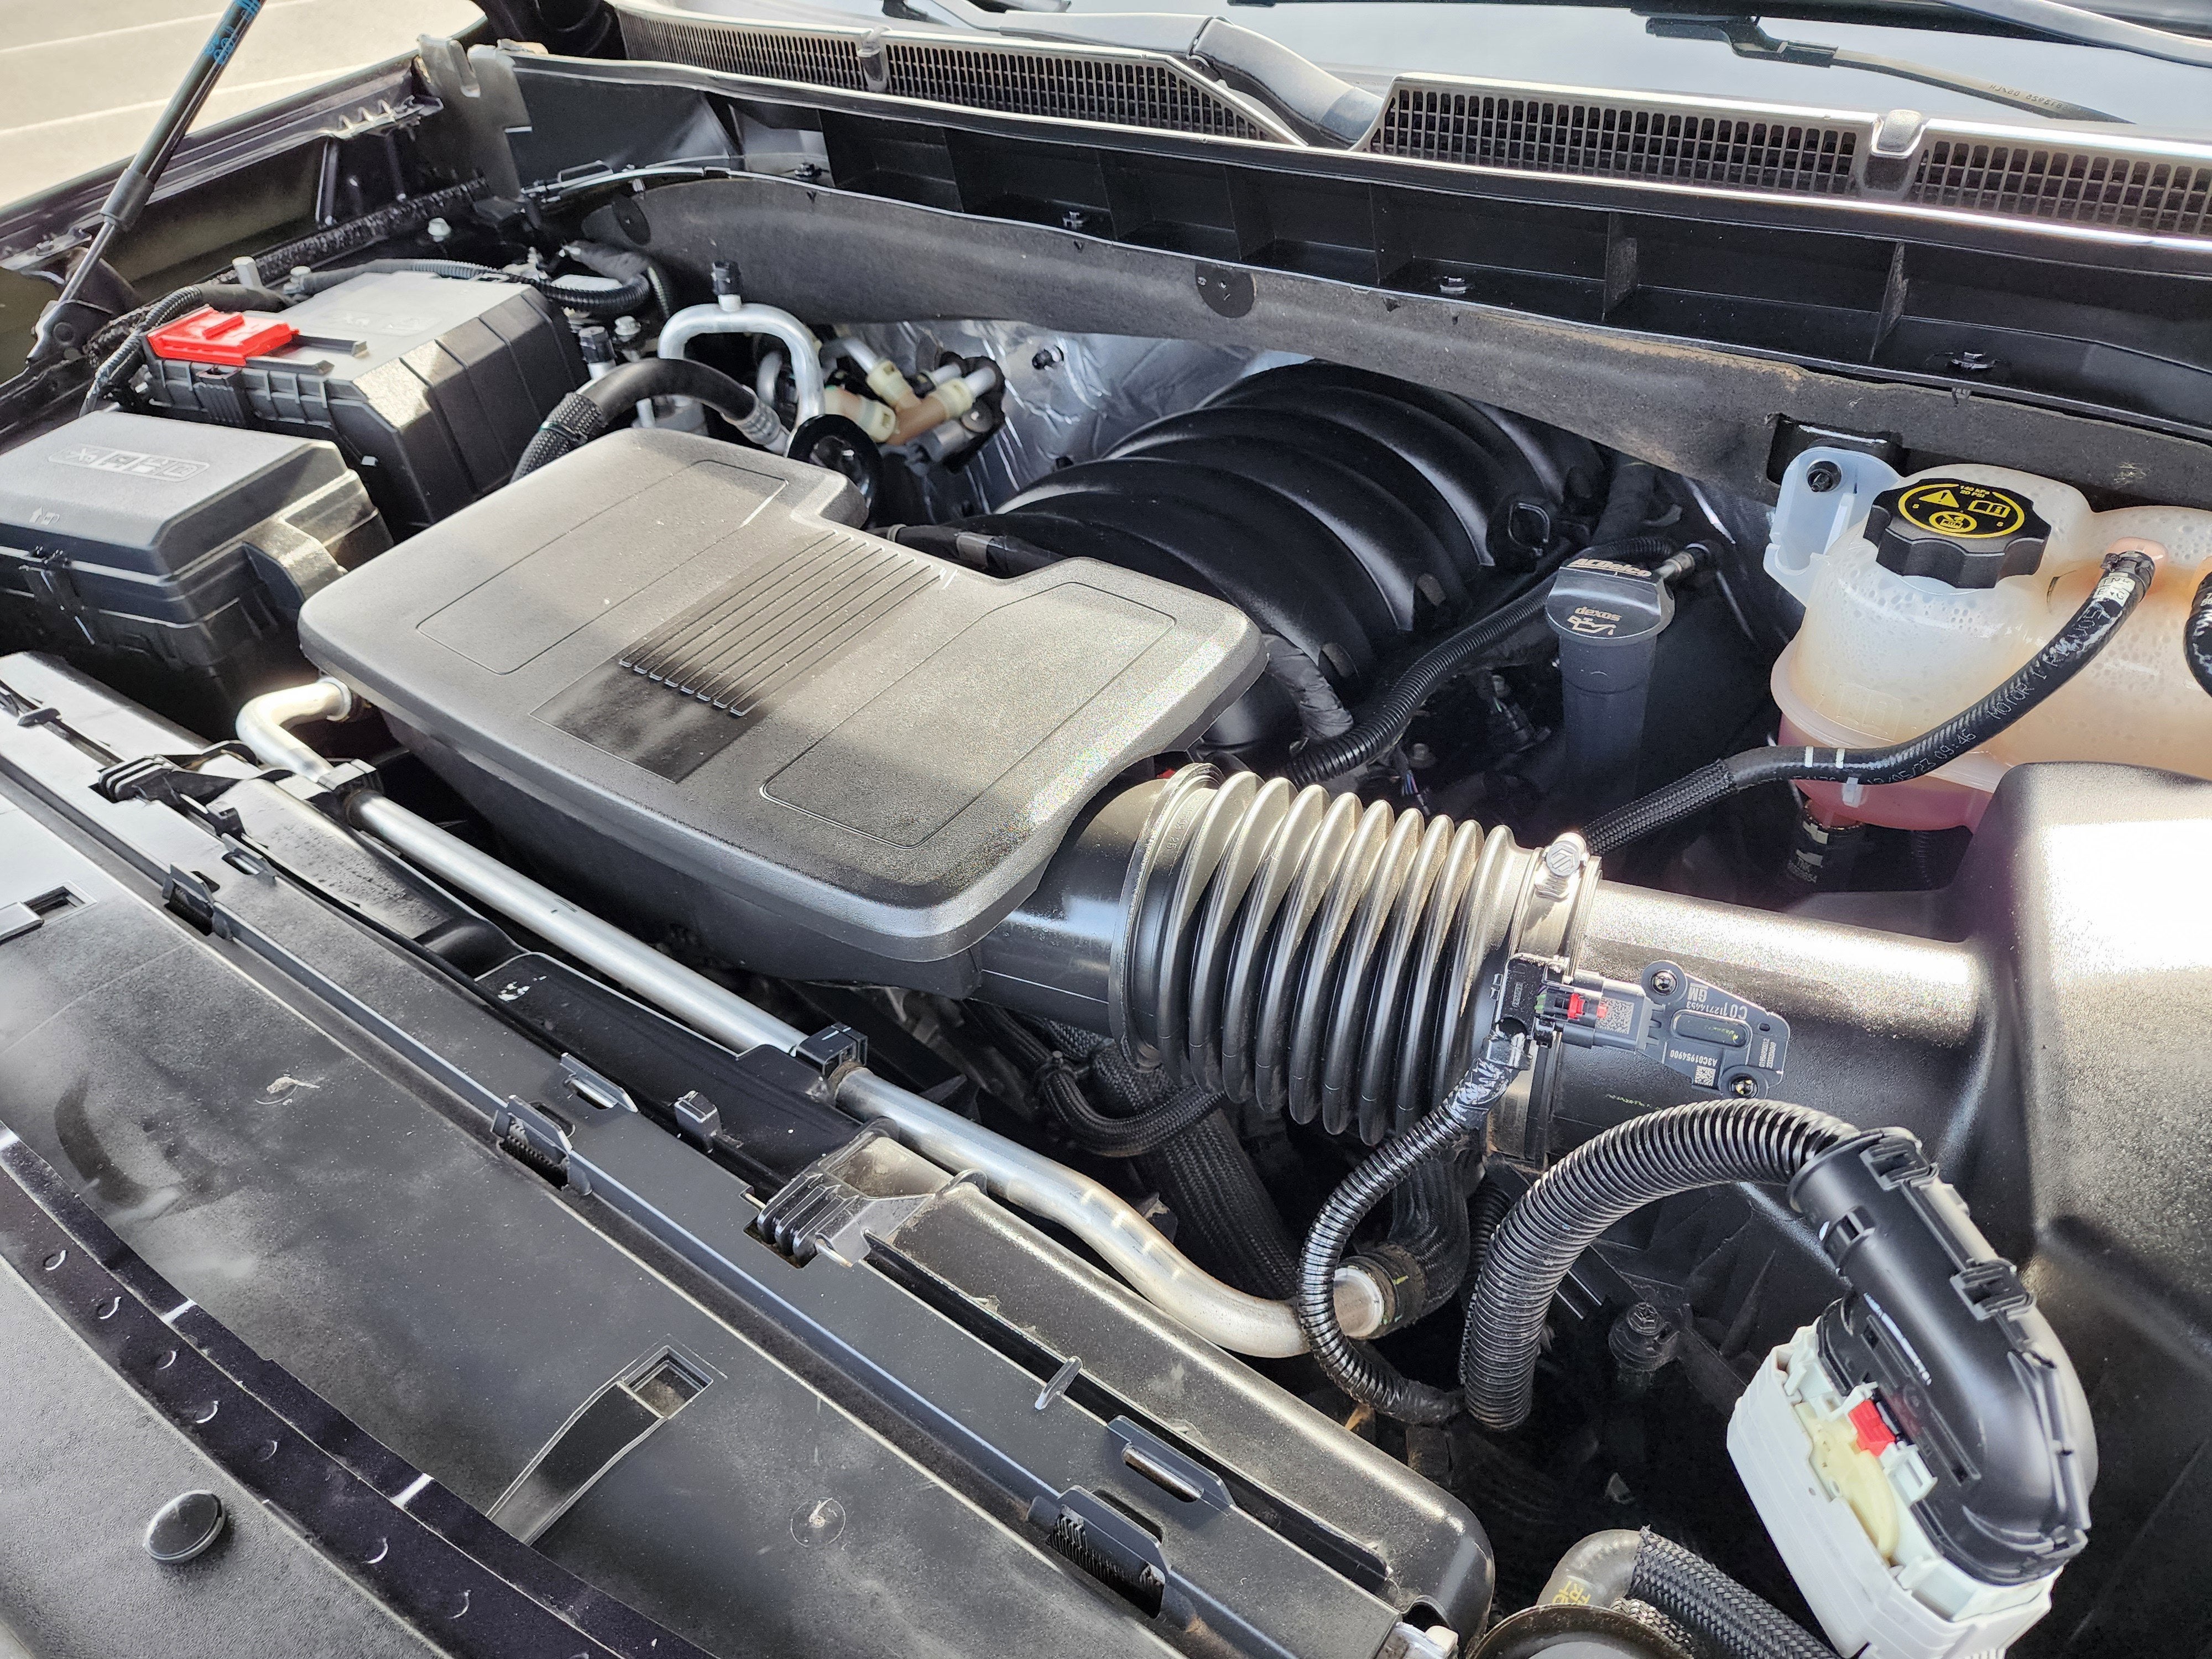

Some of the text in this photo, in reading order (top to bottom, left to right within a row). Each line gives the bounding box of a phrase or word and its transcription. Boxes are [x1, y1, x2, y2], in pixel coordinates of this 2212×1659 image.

[1567, 558, 1652, 577] ACDelco
[1574, 606, 1622, 622] dexos
[1986, 683, 2035, 720] MOTOR
[1687, 985, 1708, 1003] GM
[1670, 1050, 1718, 1067] A3C01954900
[1558, 1580, 1592, 1606] FRT
